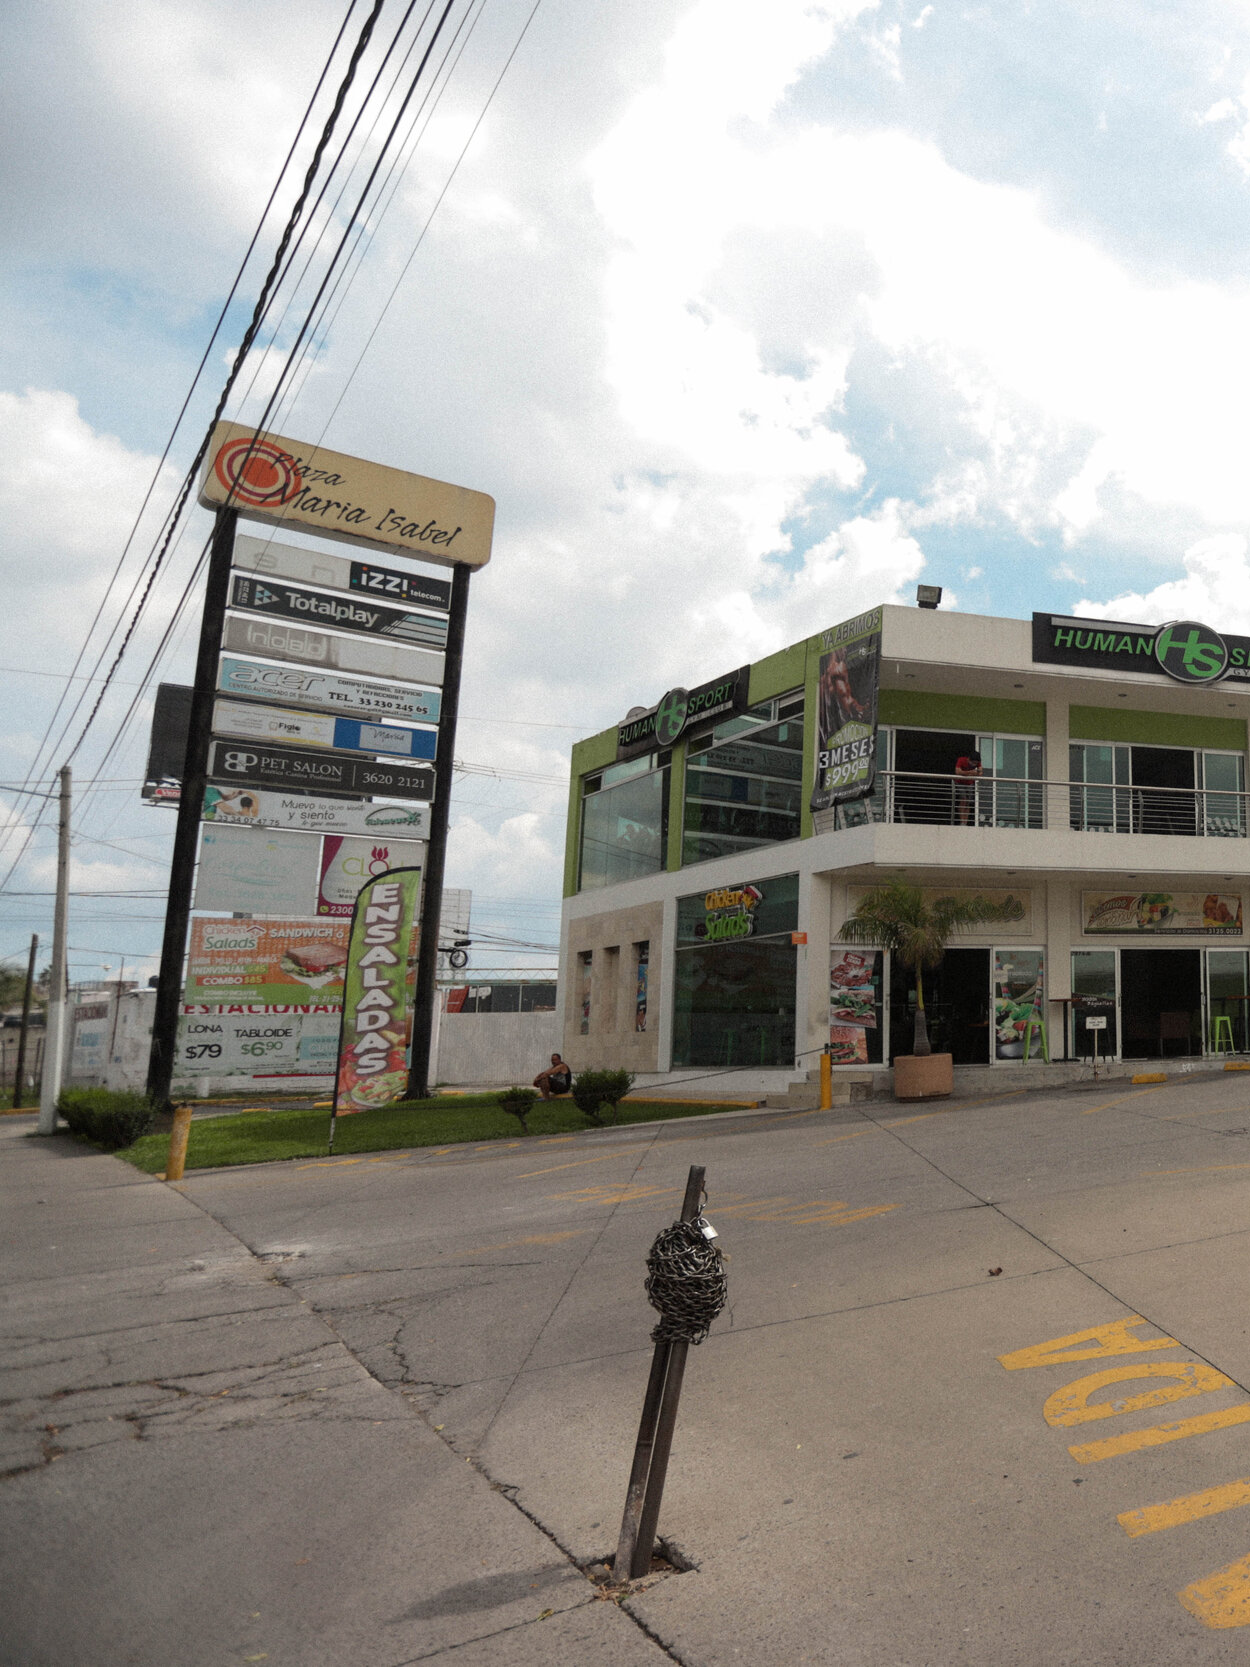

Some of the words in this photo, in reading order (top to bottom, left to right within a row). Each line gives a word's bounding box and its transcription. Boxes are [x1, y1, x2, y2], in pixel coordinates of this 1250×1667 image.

[269, 452, 347, 486] Plaza
[376, 508, 462, 548] Isabel
[285, 591, 381, 628] Totalplay
[834, 610, 880, 644] ABRIMOS
[1054, 628, 1154, 656] HUMAN
[229, 665, 326, 692] acer
[328, 691, 353, 703] TEL.
[359, 697, 372, 706] 33
[374, 700, 393, 709] 230
[395, 703, 414, 713] 245
[416, 706, 429, 715] 65
[618, 715, 656, 747] HUMAN
[687, 682, 733, 715] SPORT
[819, 751, 829, 769] 3
[830, 734, 875, 767] MESES
[260, 757, 290, 770] PET
[293, 761, 344, 776] SALON
[362, 772, 394, 786] 3620
[398, 776, 426, 790] 2121
[281, 800, 316, 810] Muevo
[300, 810, 336, 820] siento
[270, 818, 280, 827] 75
[203, 924, 247, 936] Chicken
[269, 927, 334, 939] SANDWICH
[204, 936, 257, 951] Salads
[191, 965, 246, 975] INDIVIDUAL
[202, 976, 243, 986] COMBO
[356, 882, 400, 1074] ENSALADAS
[188, 1025, 224, 1034] LONA
[234, 1028, 293, 1039] TABLOIDE
[185, 1043, 223, 1059] $79
